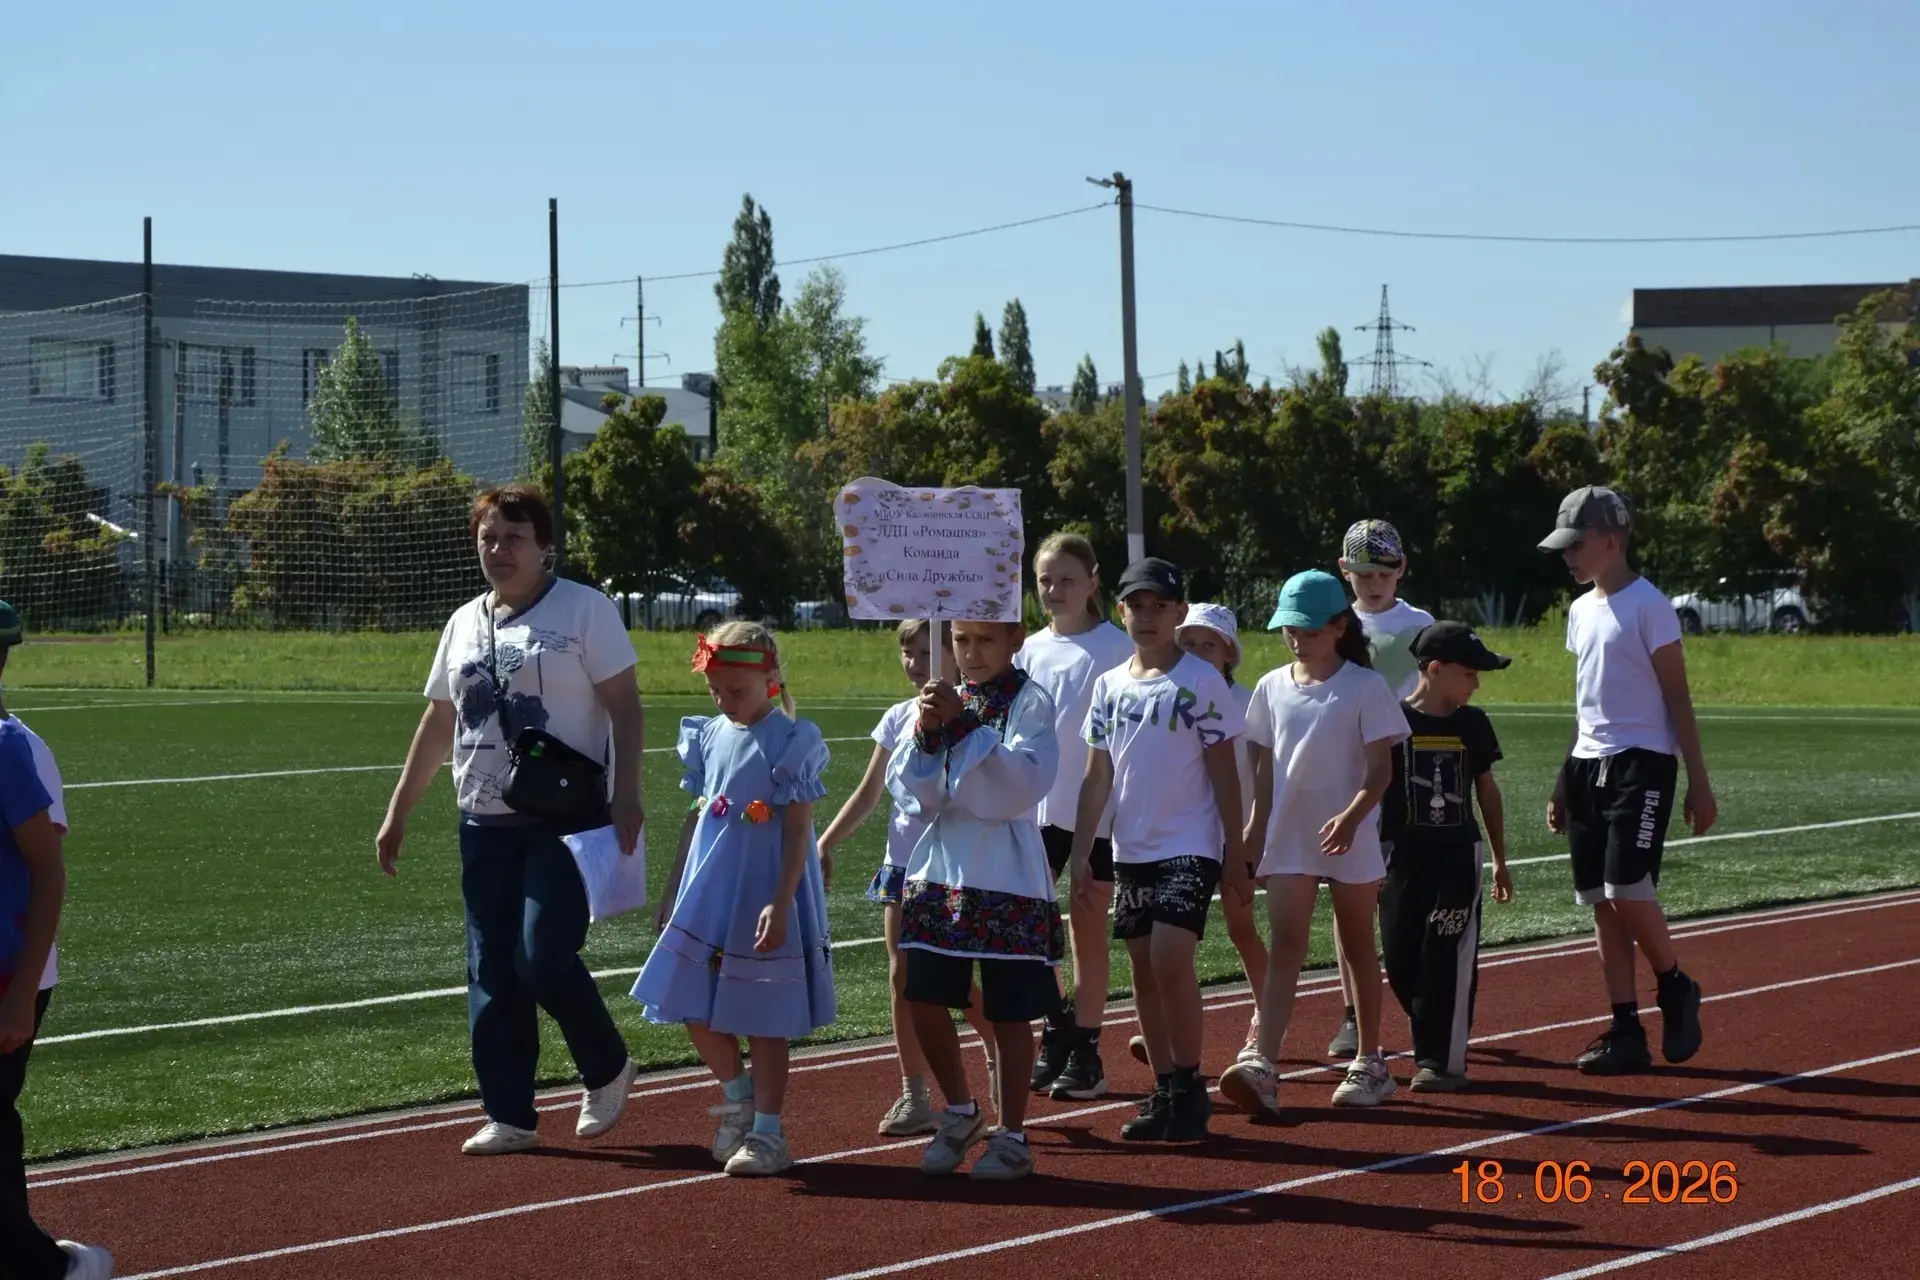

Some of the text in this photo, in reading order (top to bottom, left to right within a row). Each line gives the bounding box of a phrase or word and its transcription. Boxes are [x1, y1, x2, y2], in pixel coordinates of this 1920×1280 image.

[965, 511, 990, 520] СОШ
[877, 524, 986, 538] ЛДП «Ромашка»
[903, 546, 960, 559] Команда
[879, 569, 983, 584] «Сила Дружбы»
